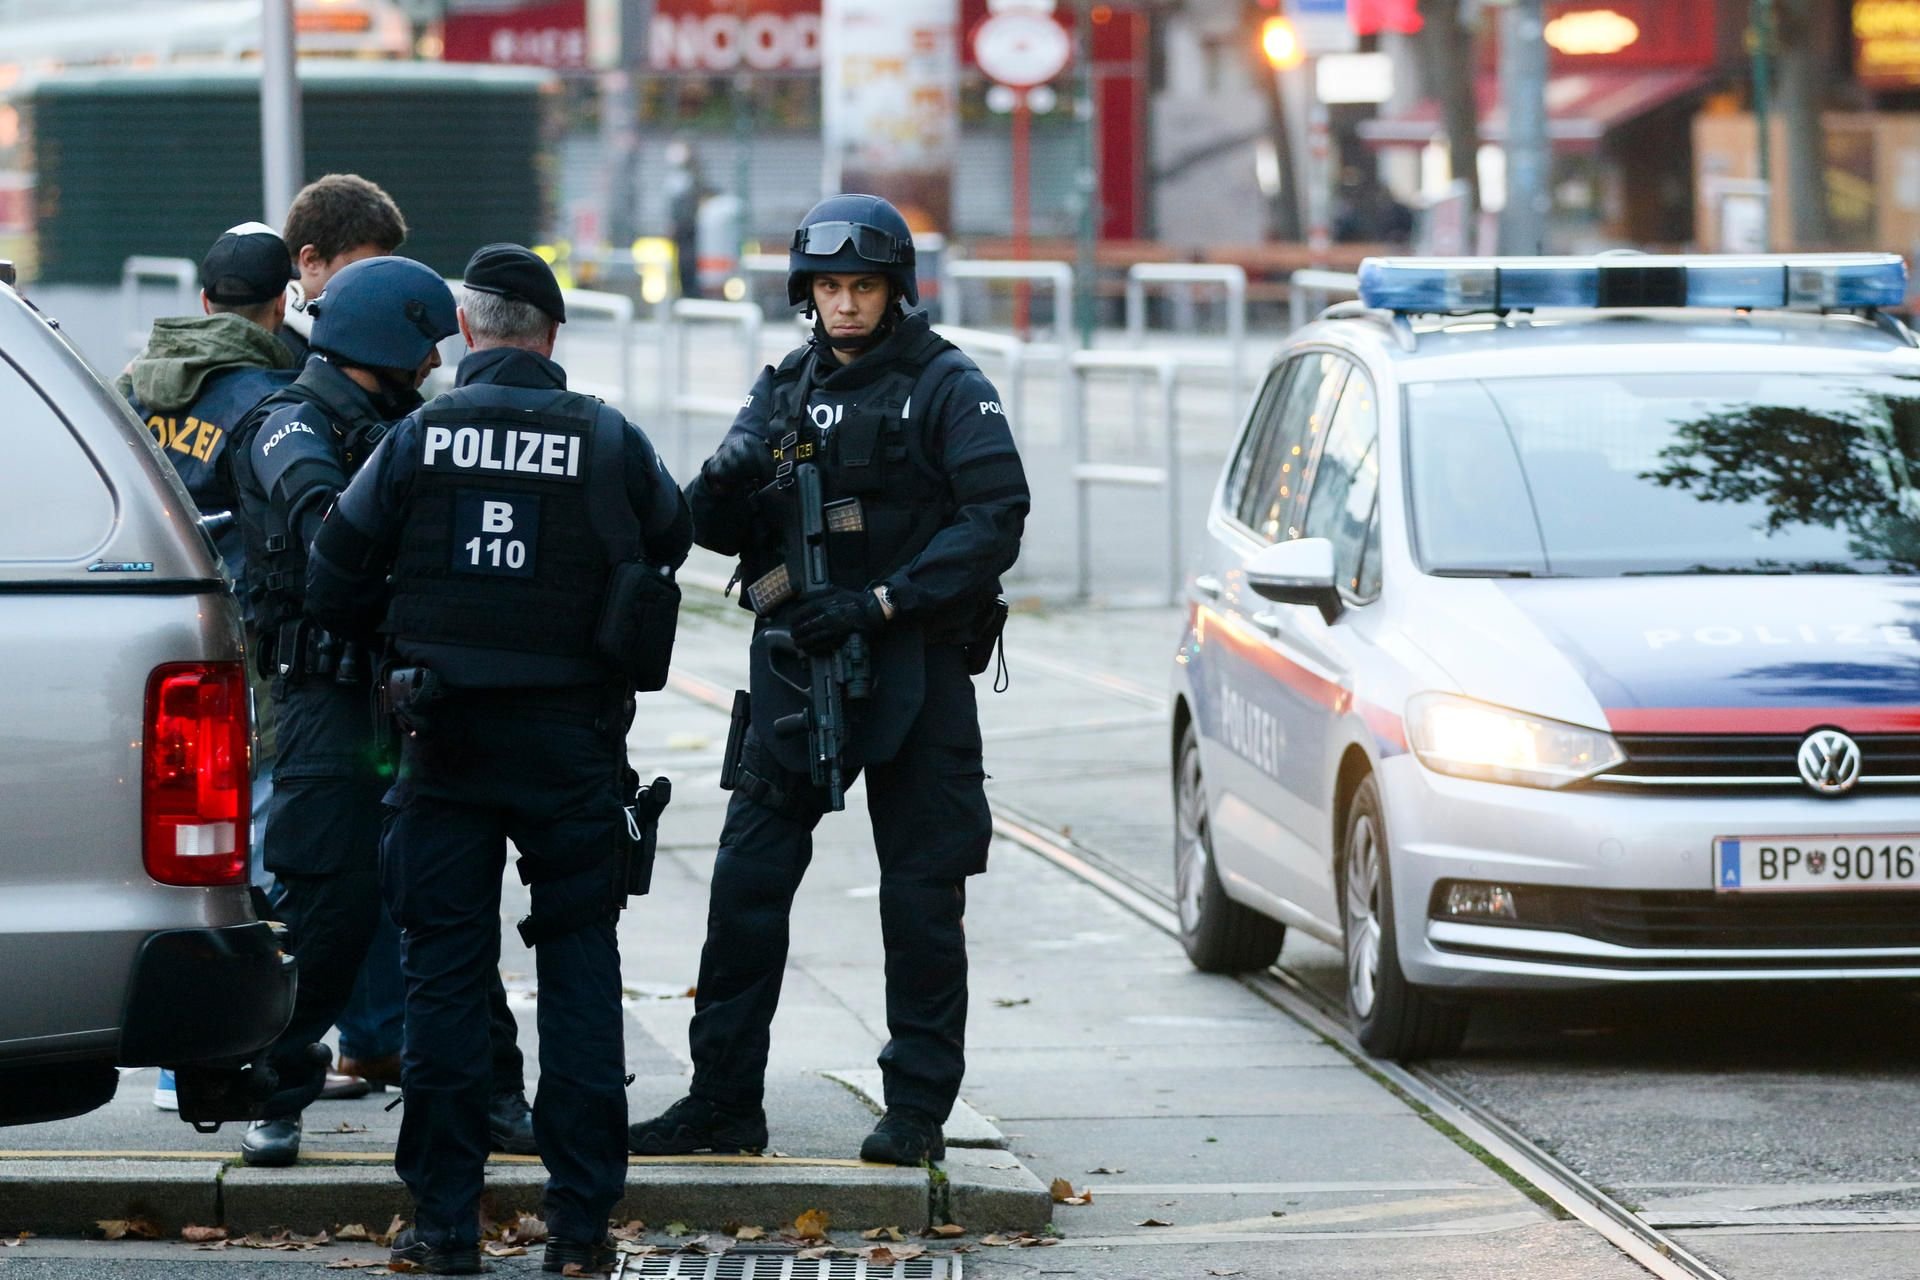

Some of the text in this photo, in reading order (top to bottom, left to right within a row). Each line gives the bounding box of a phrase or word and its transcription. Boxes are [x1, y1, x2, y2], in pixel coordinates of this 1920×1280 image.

[262, 421, 315, 456] POLIZEI
[423, 426, 581, 477] POLIZEI
[482, 500, 514, 534] B
[465, 536, 526, 569] 110
[1221, 684, 1279, 778] POLIZEI
[1759, 845, 1920, 881] BP 9016
